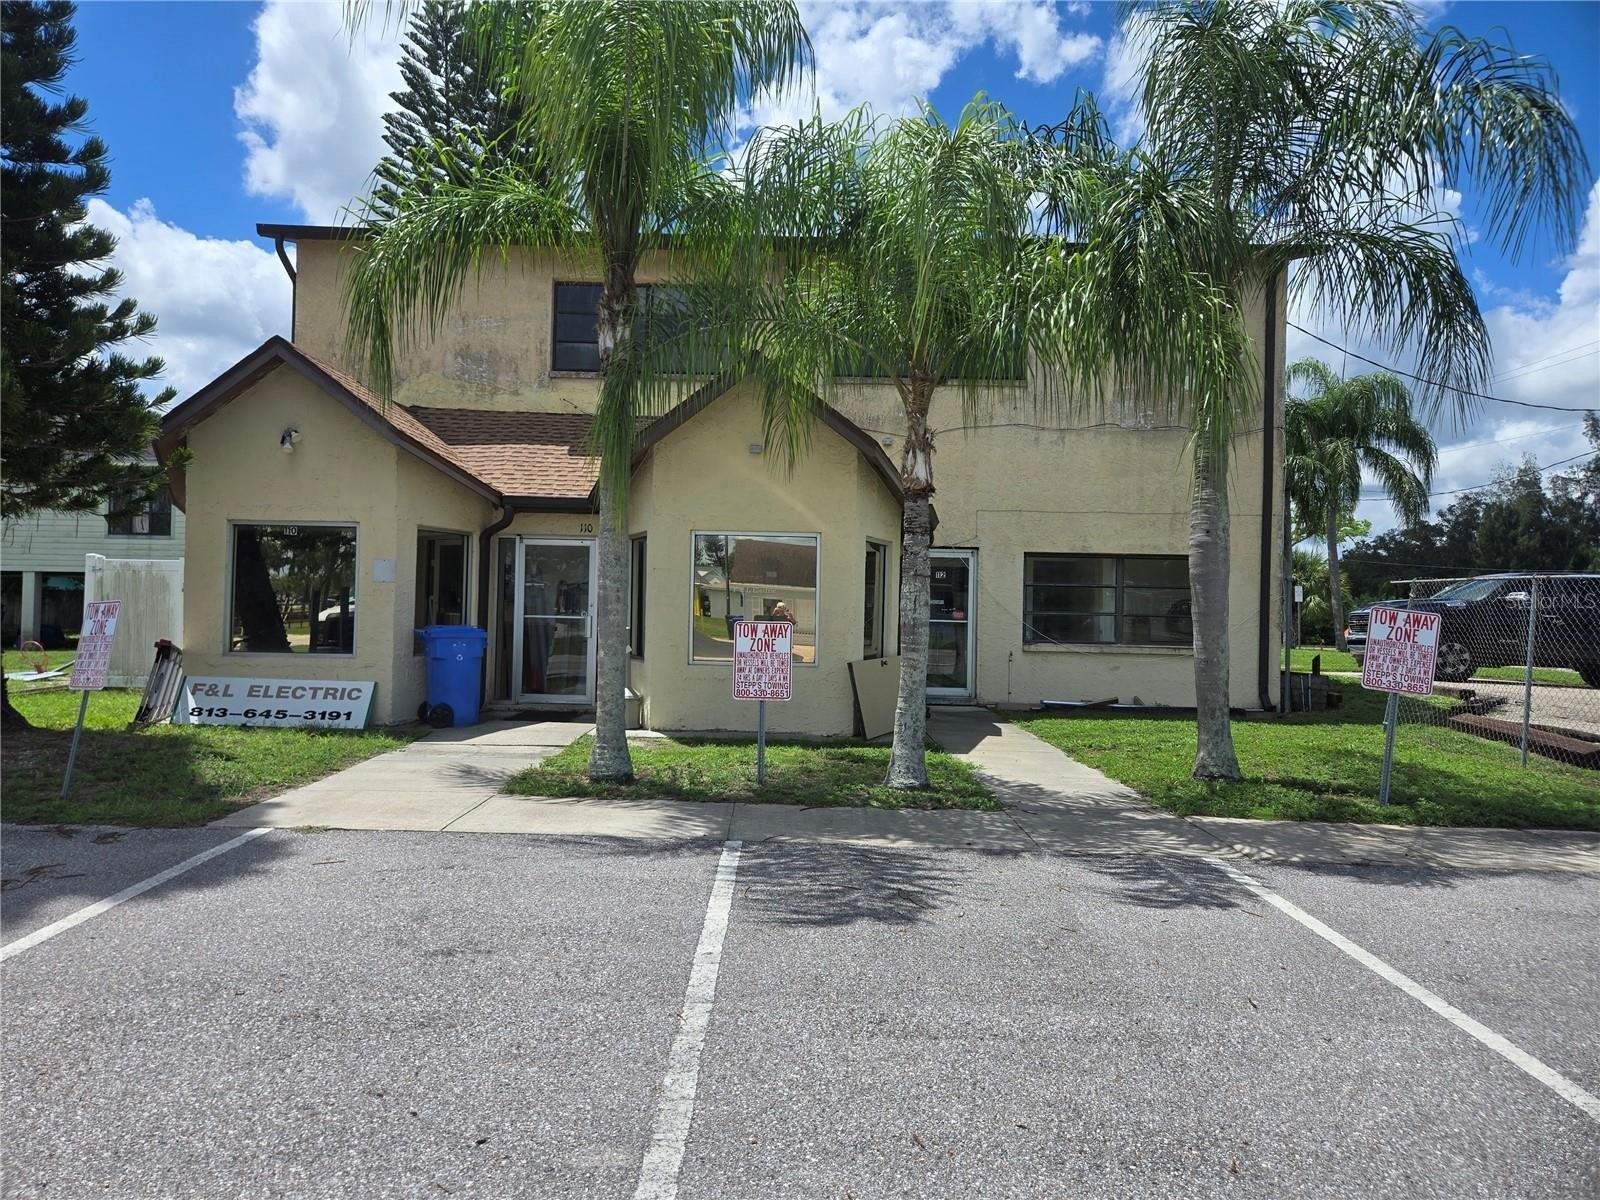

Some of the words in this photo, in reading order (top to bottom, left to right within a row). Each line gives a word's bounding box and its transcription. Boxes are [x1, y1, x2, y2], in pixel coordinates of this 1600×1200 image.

[580, 523, 593, 533] 110
[87, 604, 100, 620] TOW
[101, 603, 119, 619] AWAY
[1374, 610, 1398, 626] TOW
[1403, 613, 1436, 630] AWAY
[90, 620, 108, 635] ZONE
[737, 624, 758, 638] TOW
[763, 624, 790, 638] AWAY
[1386, 626, 1420, 644] ZONE
[750, 638, 776, 652] ZONE
[1370, 640, 1408, 650] UNAUTHORIZED
[1410, 644, 1434, 653] VEHICLES
[770, 652, 789, 660] VEHICLES
[1377, 646, 1396, 656] VESSELS
[1398, 649, 1408, 658] WILL
[1418, 652, 1433, 661] TOWED
[1410, 660, 1432, 670] EXPENSE
[764, 682, 788, 690] TOWING
[1366, 678, 1429, 692] 800-330-8651
[1400, 674, 1430, 685] TOWING
[191, 682, 234, 698] F&L
[247, 684, 362, 700] ELECTRIC
[736, 689, 788, 697] 800-330-8651
[189, 706, 352, 720] 813-645-3191
